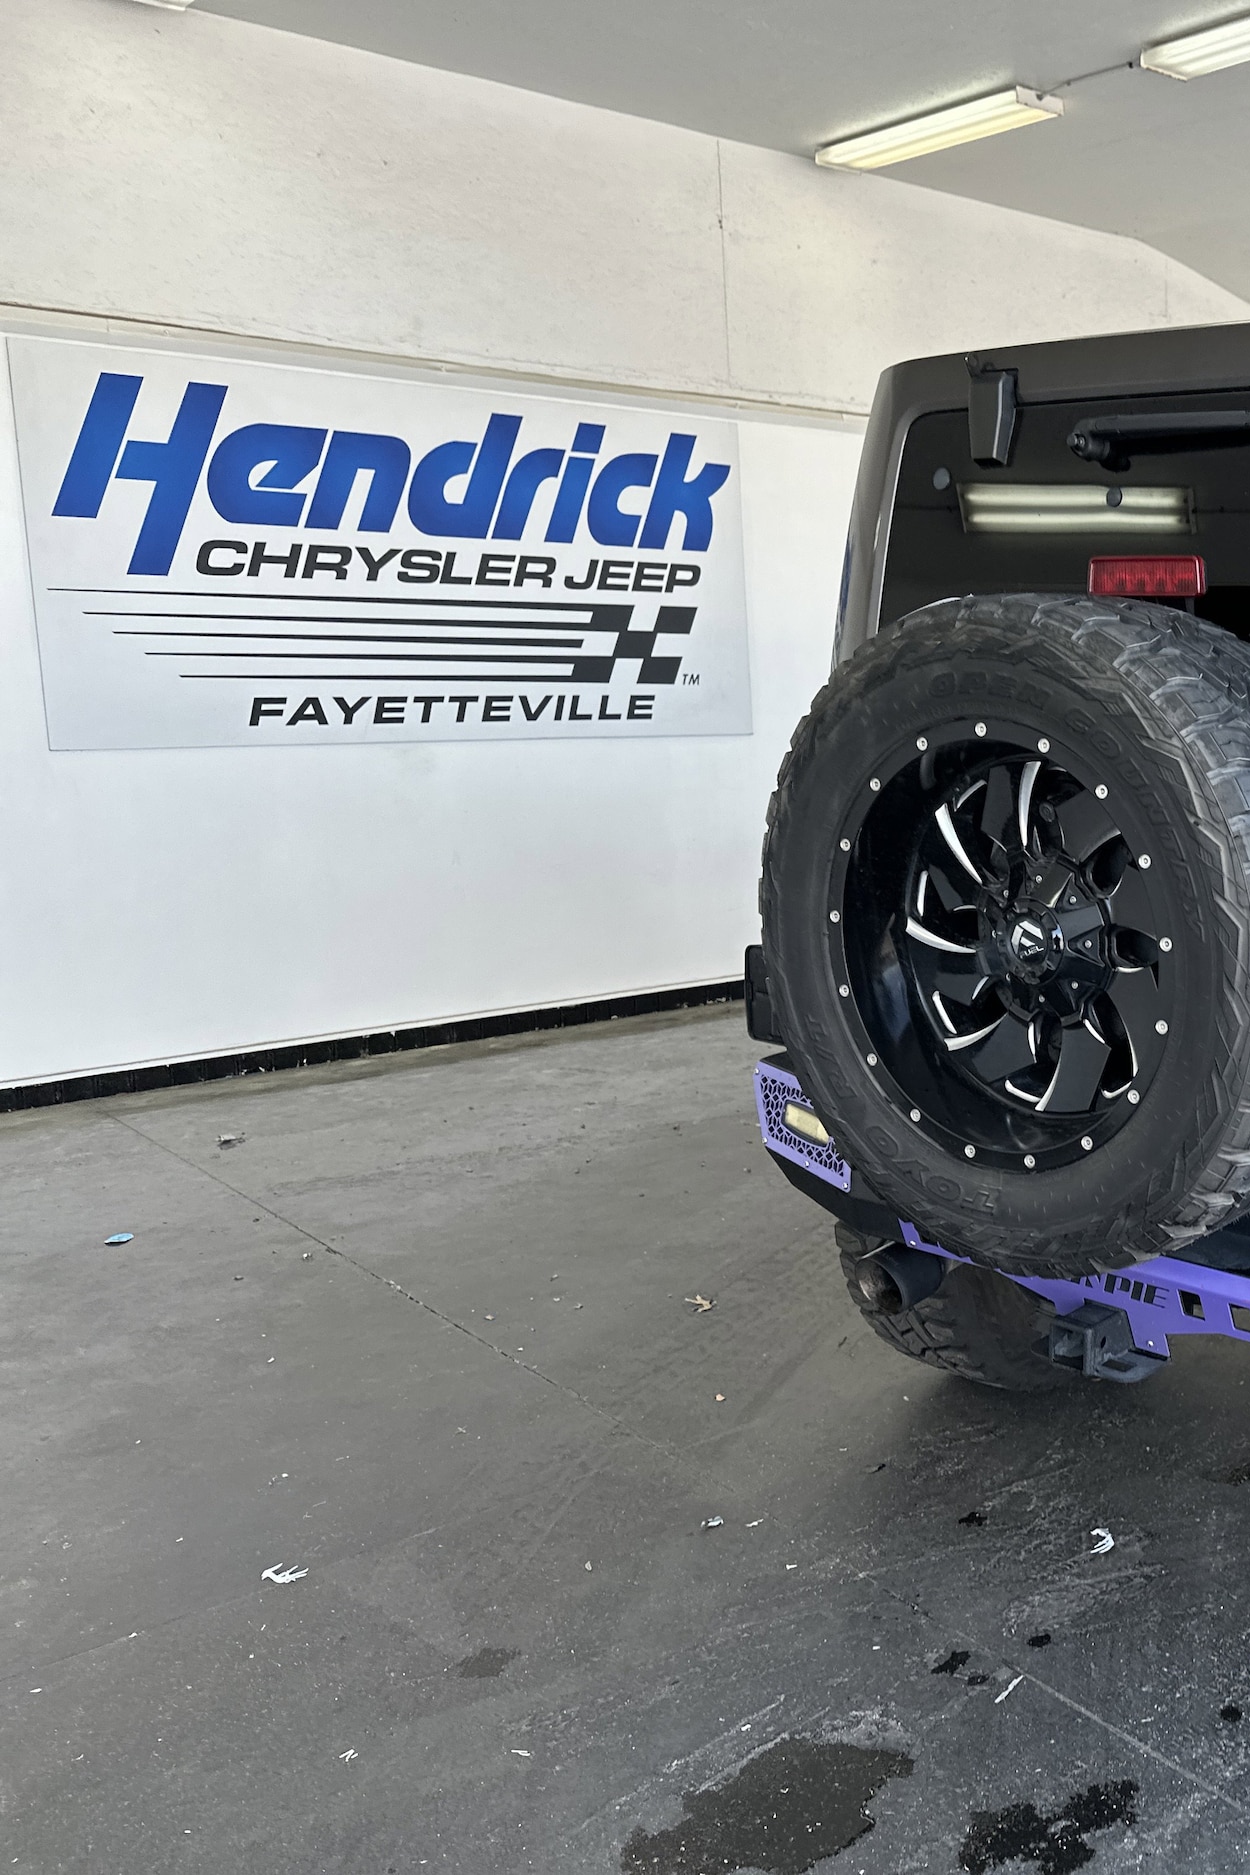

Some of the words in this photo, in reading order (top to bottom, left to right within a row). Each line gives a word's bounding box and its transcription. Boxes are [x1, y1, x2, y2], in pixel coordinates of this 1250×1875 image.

[53, 373, 729, 577] Hendrick
[196, 540, 557, 588] CHRYSLER
[565, 560, 701, 593] JEEP
[683, 673, 700, 685] TM
[928, 670, 1051, 711] OPEN
[250, 695, 656, 727] FAYETTEVILLE
[1019, 945, 1045, 960] FUEL
[864, 1125, 995, 1215] TOYO
